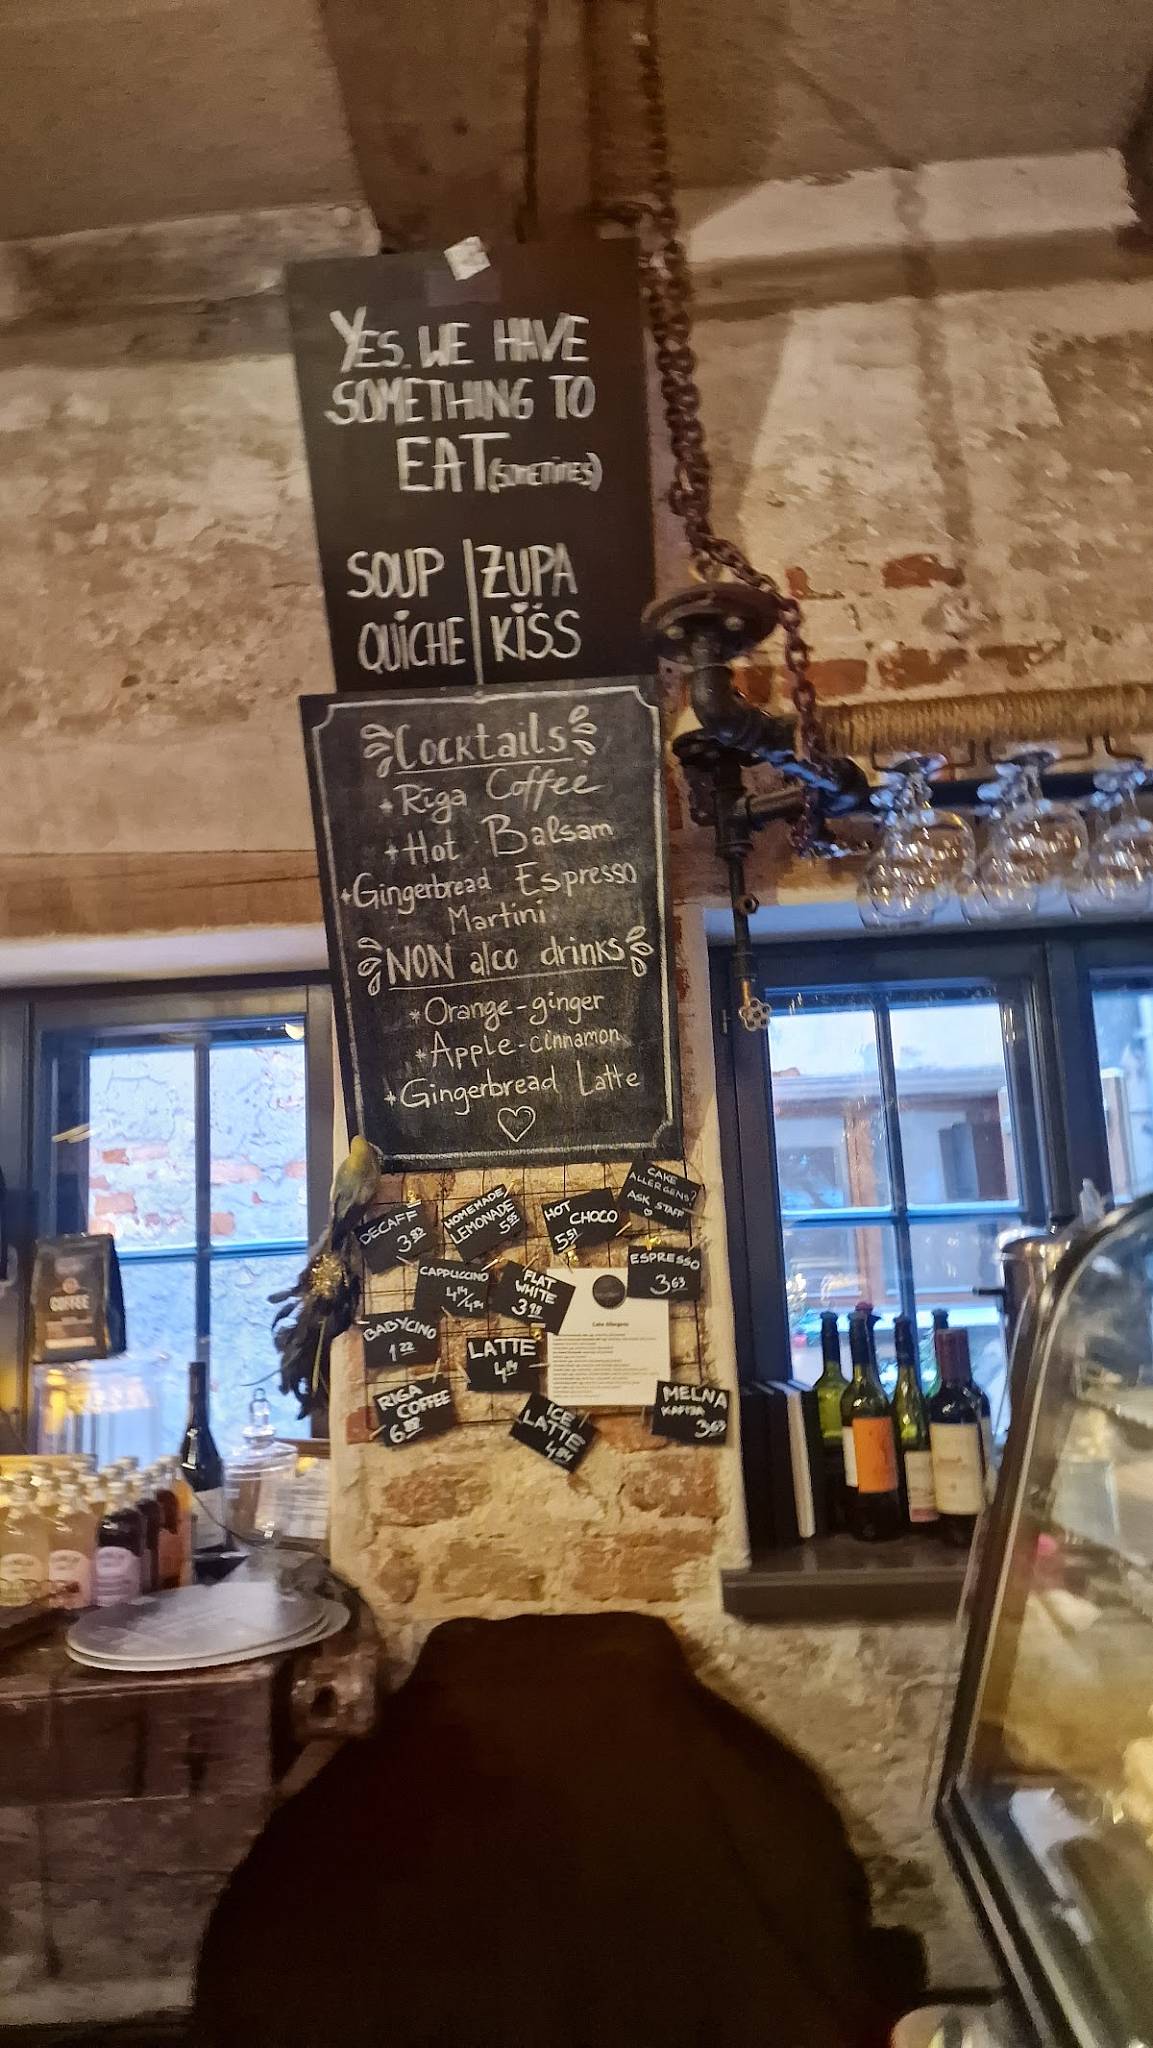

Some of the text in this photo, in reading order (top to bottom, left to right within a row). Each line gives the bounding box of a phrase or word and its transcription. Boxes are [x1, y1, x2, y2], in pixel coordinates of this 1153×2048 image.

[418, 322, 475, 369] WE
[493, 312, 590, 362] HAVE
[324, 374, 596, 425] SOMETHING TO
[396, 432, 511, 492] EAT
[346, 547, 446, 599] SOUP
[474, 542, 579, 599] ZUPA
[357, 609, 467, 676] QUICHE
[394, 711, 570, 770] Cocktails
[485, 764, 606, 812] Coffee
[401, 813, 616, 866] Hot Balsam
[352, 860, 639, 915] Gingerbread Espresso
[447, 899, 547, 936] Martini
[385, 935, 627, 986] NON alco drinks
[400, 1058, 642, 1116] Gingerbread Latte
[647, 1166, 679, 1185] CAKE
[444, 1187, 505, 1229] HOMEMADE
[449, 1198, 515, 1244] LEMONADE
[543, 1200, 572, 1222] HOT
[569, 1209, 619, 1226] CHOCO
[626, 1189, 685, 1219] ASK STAFF
[359, 1209, 418, 1245] DECAFF
[419, 1266, 490, 1283] CAPPUCCINO
[523, 1269, 557, 1288] FLAT
[629, 1252, 701, 1271] ESPRESSO
[515, 1279, 558, 1305] WHITE
[362, 1316, 437, 1342] BABYCINO
[467, 1337, 538, 1360] LATTE
[376, 1384, 424, 1411] RIGA
[396, 1389, 452, 1419] COFFEE
[546, 1402, 577, 1428] ICE
[662, 1385, 728, 1409] MELNA
[522, 1409, 587, 1453] LATTE
